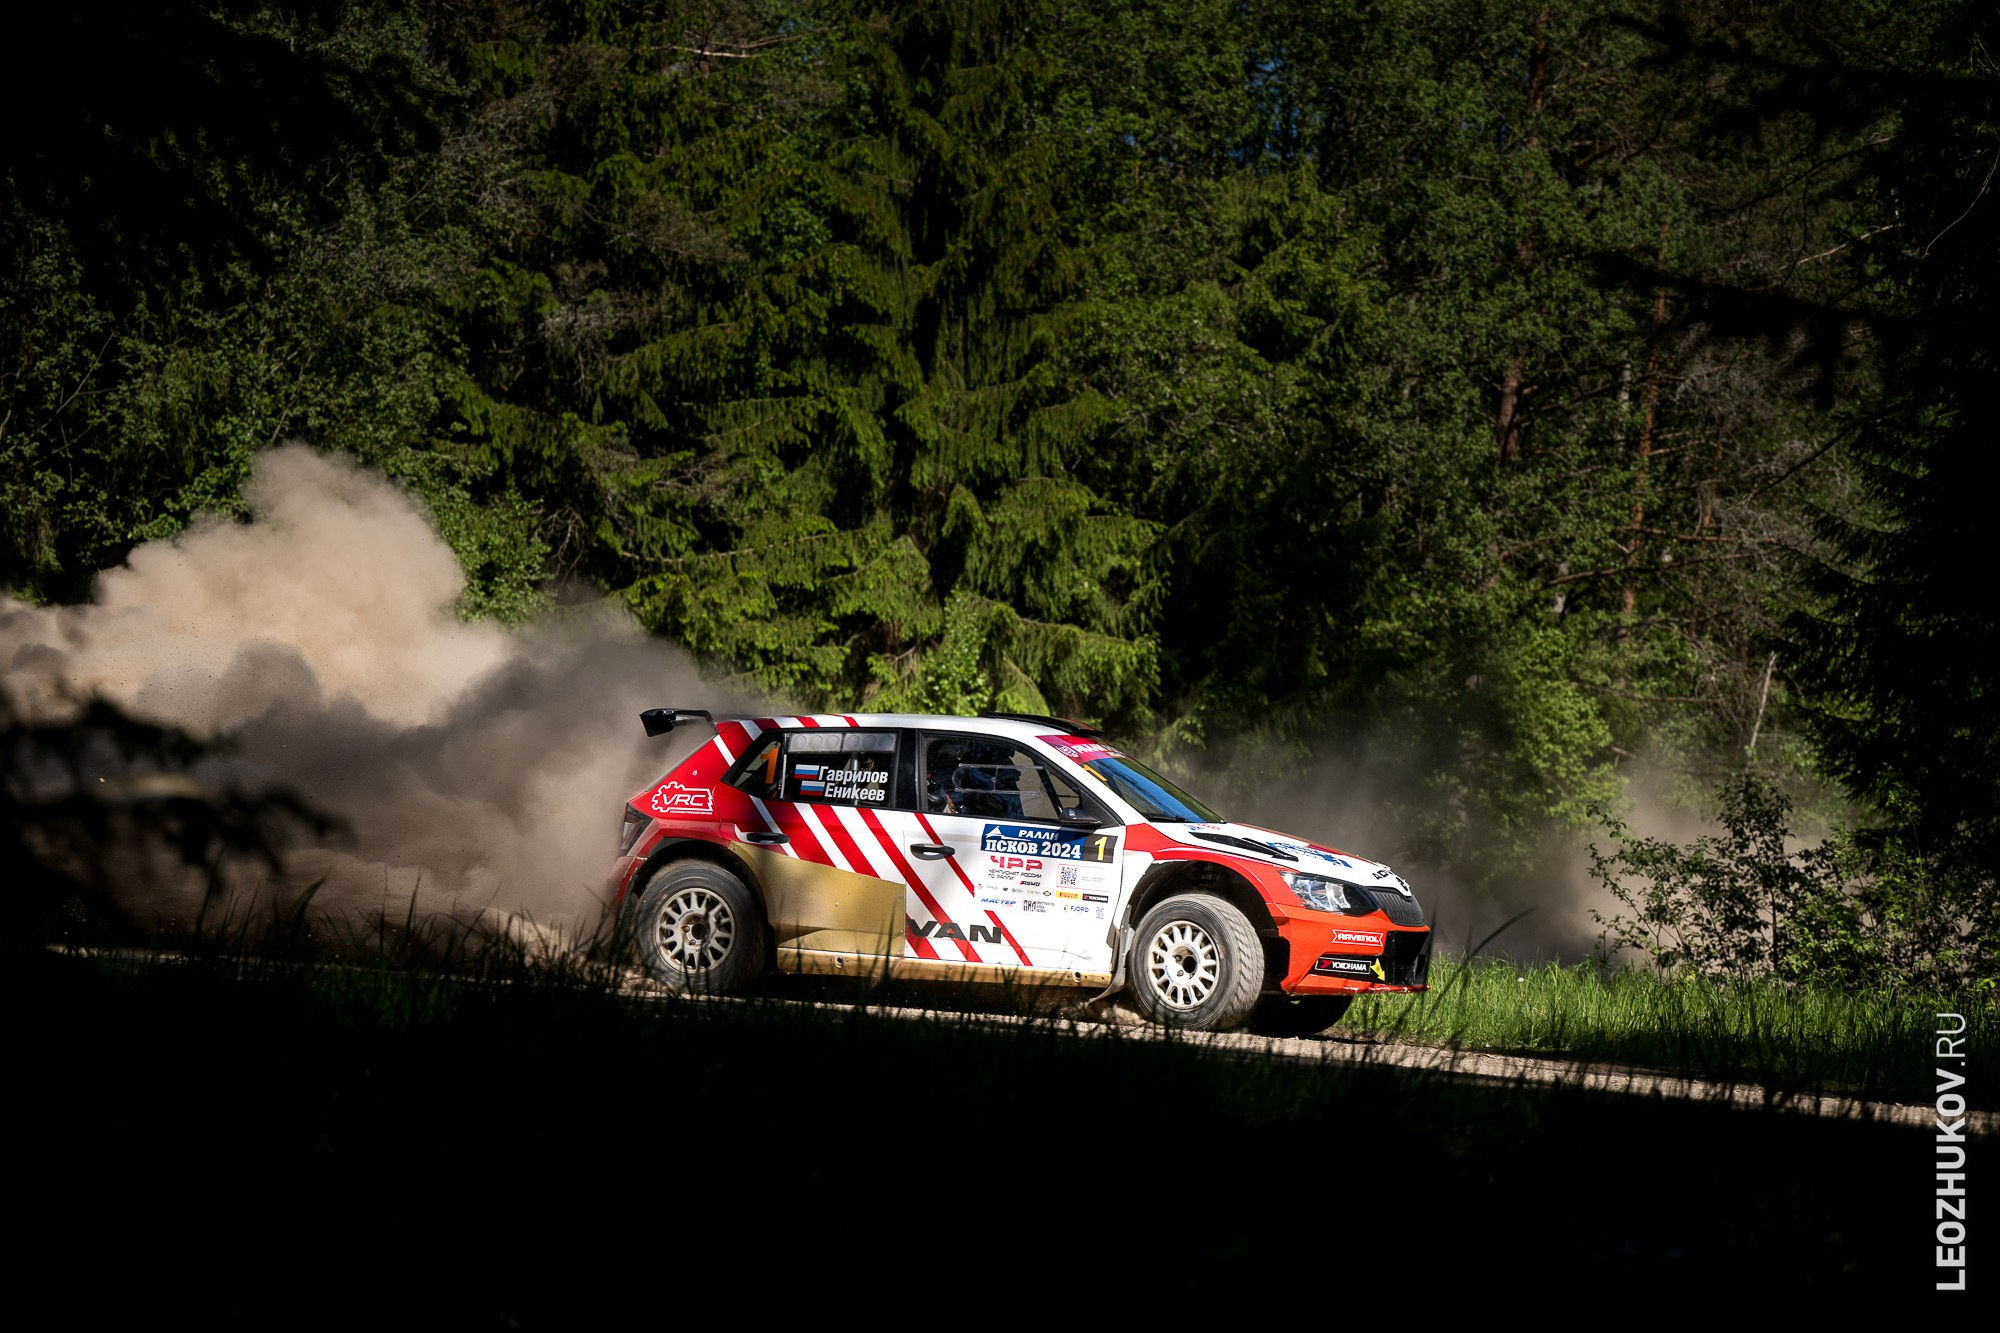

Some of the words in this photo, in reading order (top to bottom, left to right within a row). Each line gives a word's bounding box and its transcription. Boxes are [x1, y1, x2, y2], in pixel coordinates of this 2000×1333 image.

[760, 747, 779, 784] 1
[818, 766, 889, 784] Гаврилов
[663, 793, 706, 806] VRC
[824, 783, 886, 801] Еникеев
[1018, 829, 1058, 840] РАЛЛИ
[984, 839, 1038, 855] ПСКОВ
[1041, 843, 1081, 859] 2024
[1094, 836, 1108, 861] 1
[1070, 905, 1090, 913] FJORD
[1337, 933, 1380, 943] RAVENOL
[1332, 962, 1367, 971] YOKOHAMA
